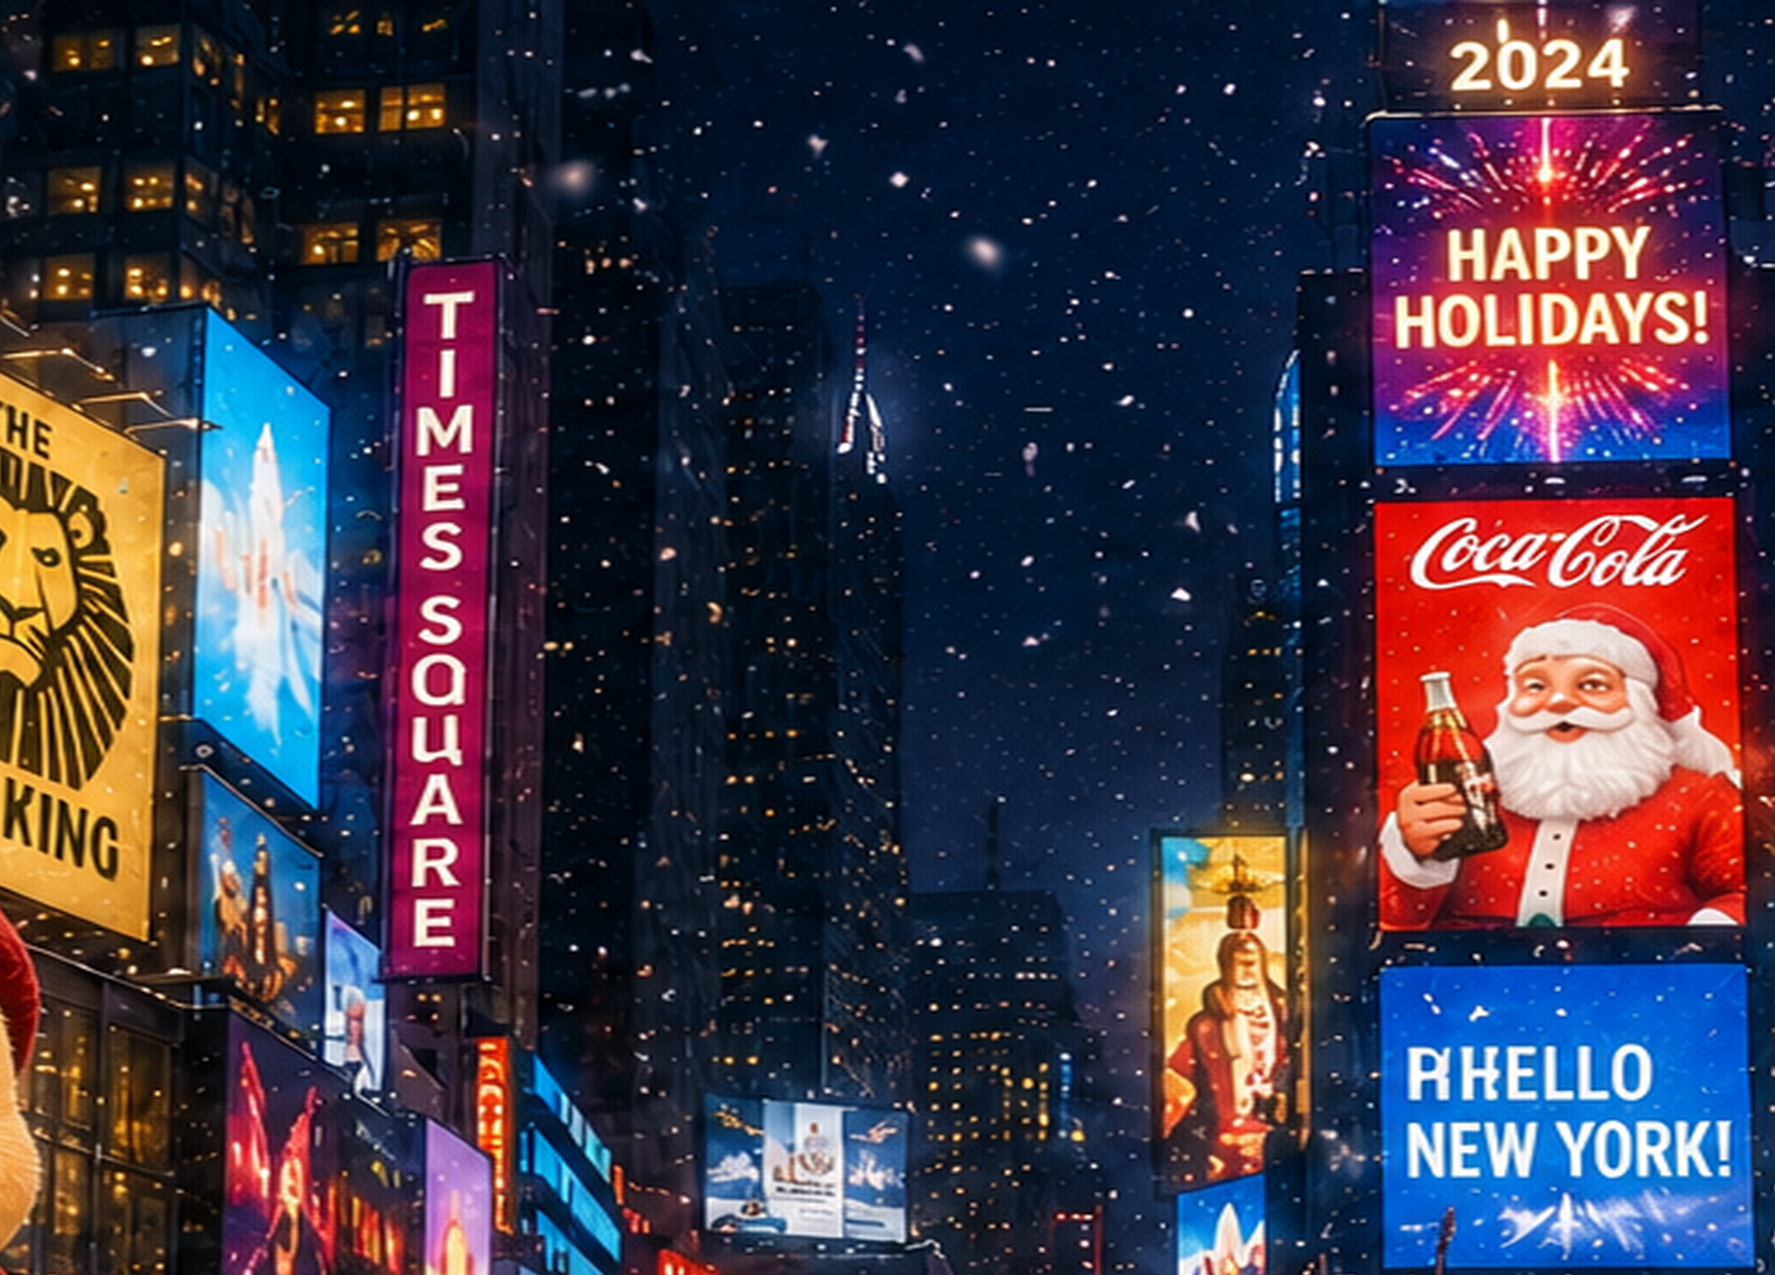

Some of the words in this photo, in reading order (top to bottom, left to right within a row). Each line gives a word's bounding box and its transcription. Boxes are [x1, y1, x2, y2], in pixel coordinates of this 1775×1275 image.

[1450, 38, 1630, 92] 2024
[1447, 226, 1650, 281] HAPPY
[1394, 291, 1711, 350] HOLIDAYS!
[415, 291, 474, 572] TIMES
[1410, 513, 1711, 590] Coca-Cola
[3, 776, 120, 882] KING
[1407, 1121, 1539, 1178] NEW
[1555, 1119, 1733, 1178] YORK!
